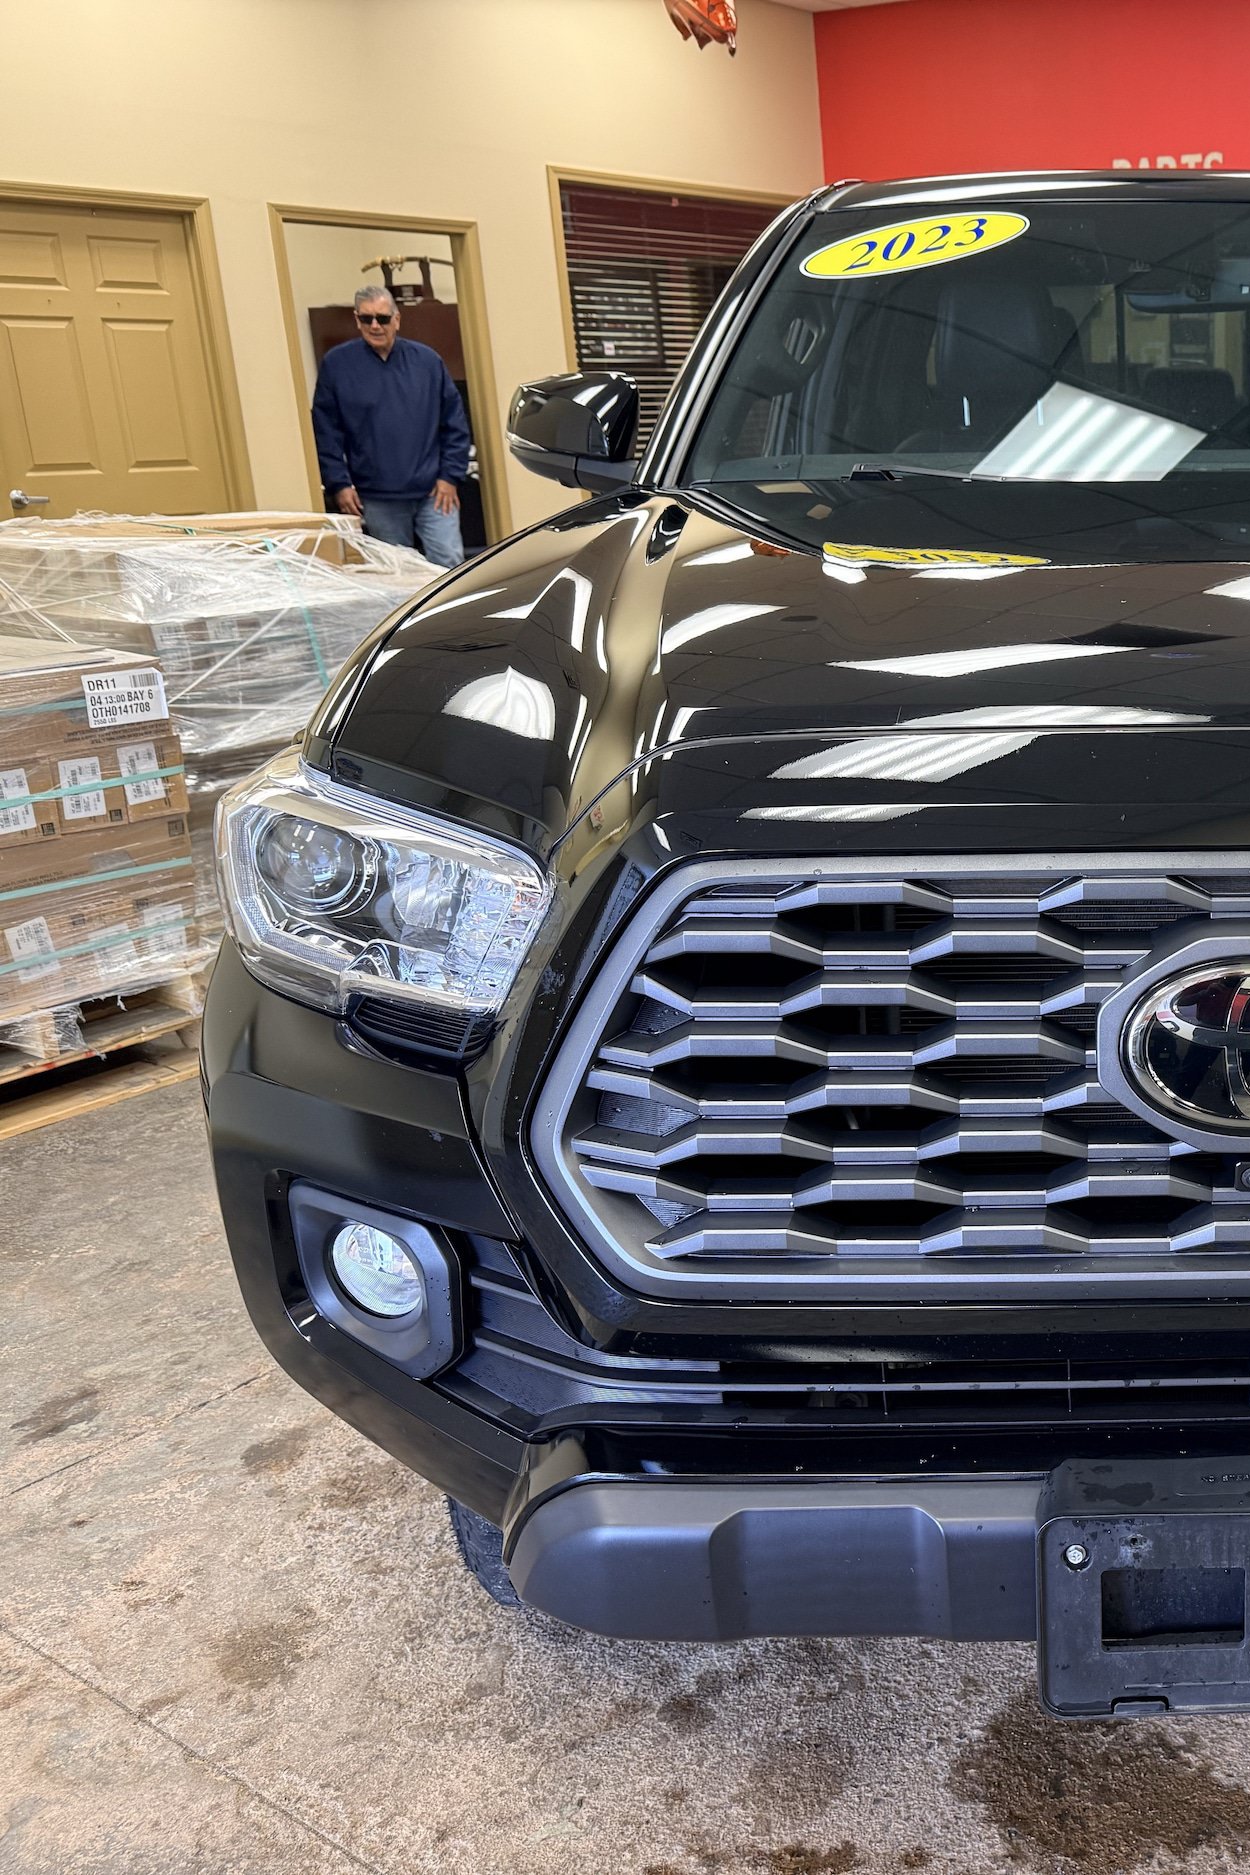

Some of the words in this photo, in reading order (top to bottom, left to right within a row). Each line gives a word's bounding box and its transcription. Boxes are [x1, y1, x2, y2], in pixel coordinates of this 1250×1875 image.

[842, 218, 988, 272] 2023
[87, 678, 117, 692] DR11
[90, 695, 102, 707] 04
[104, 693, 126, 704] 13:00
[127, 690, 145, 702] BAY
[147, 689, 154, 700] 6
